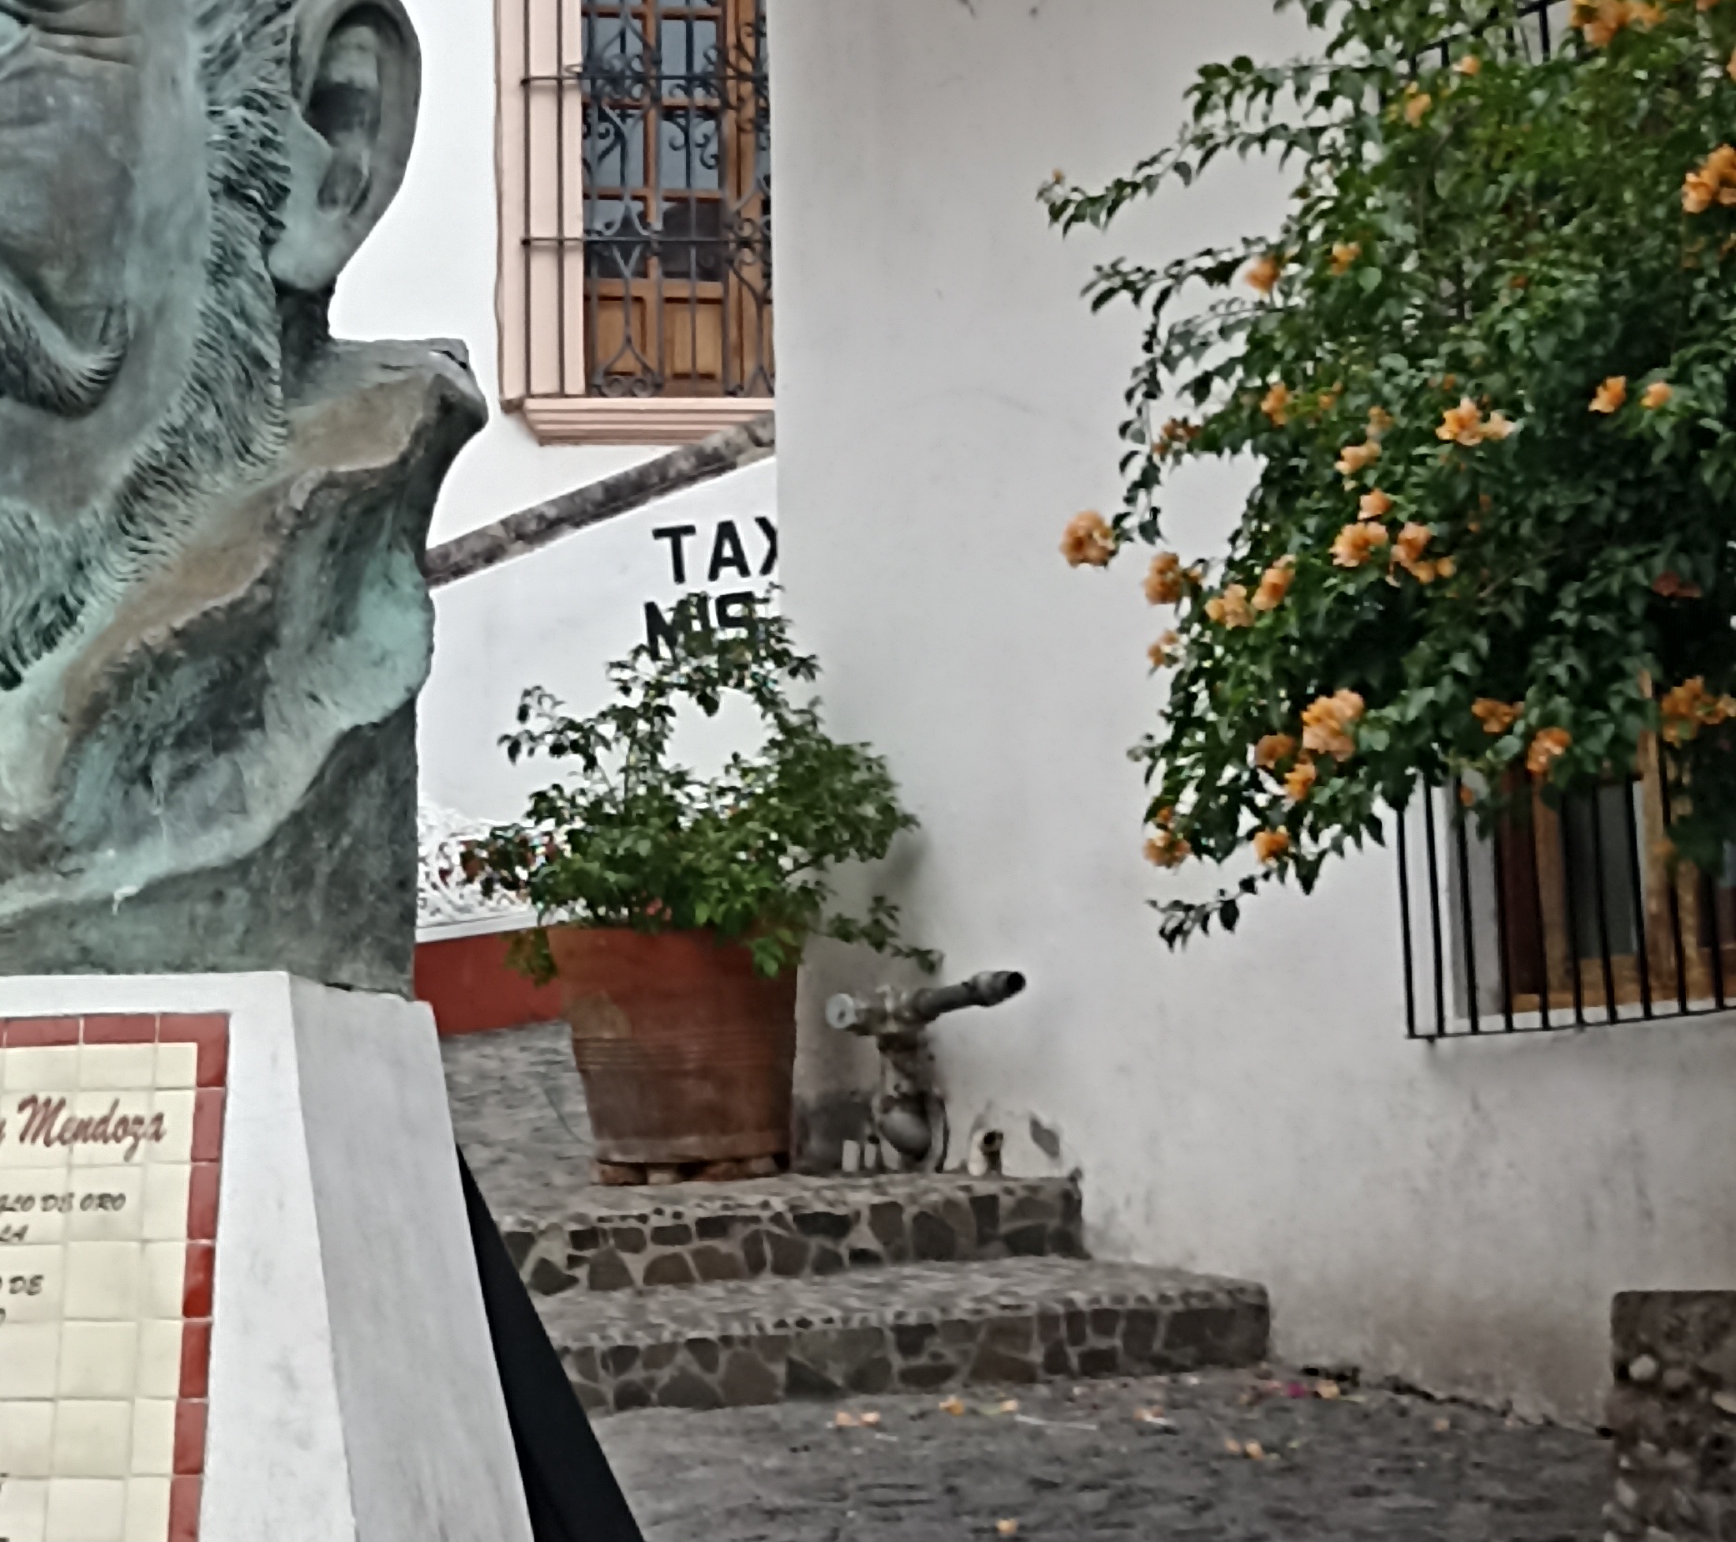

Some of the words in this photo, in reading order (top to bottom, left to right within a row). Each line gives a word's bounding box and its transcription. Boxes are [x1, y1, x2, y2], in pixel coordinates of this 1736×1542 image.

[17, 1094, 166, 1163] Mendoza
[40, 1193, 74, 1213] DE
[79, 1192, 127, 1212] ORO
[9, 1274, 44, 1296] DE
